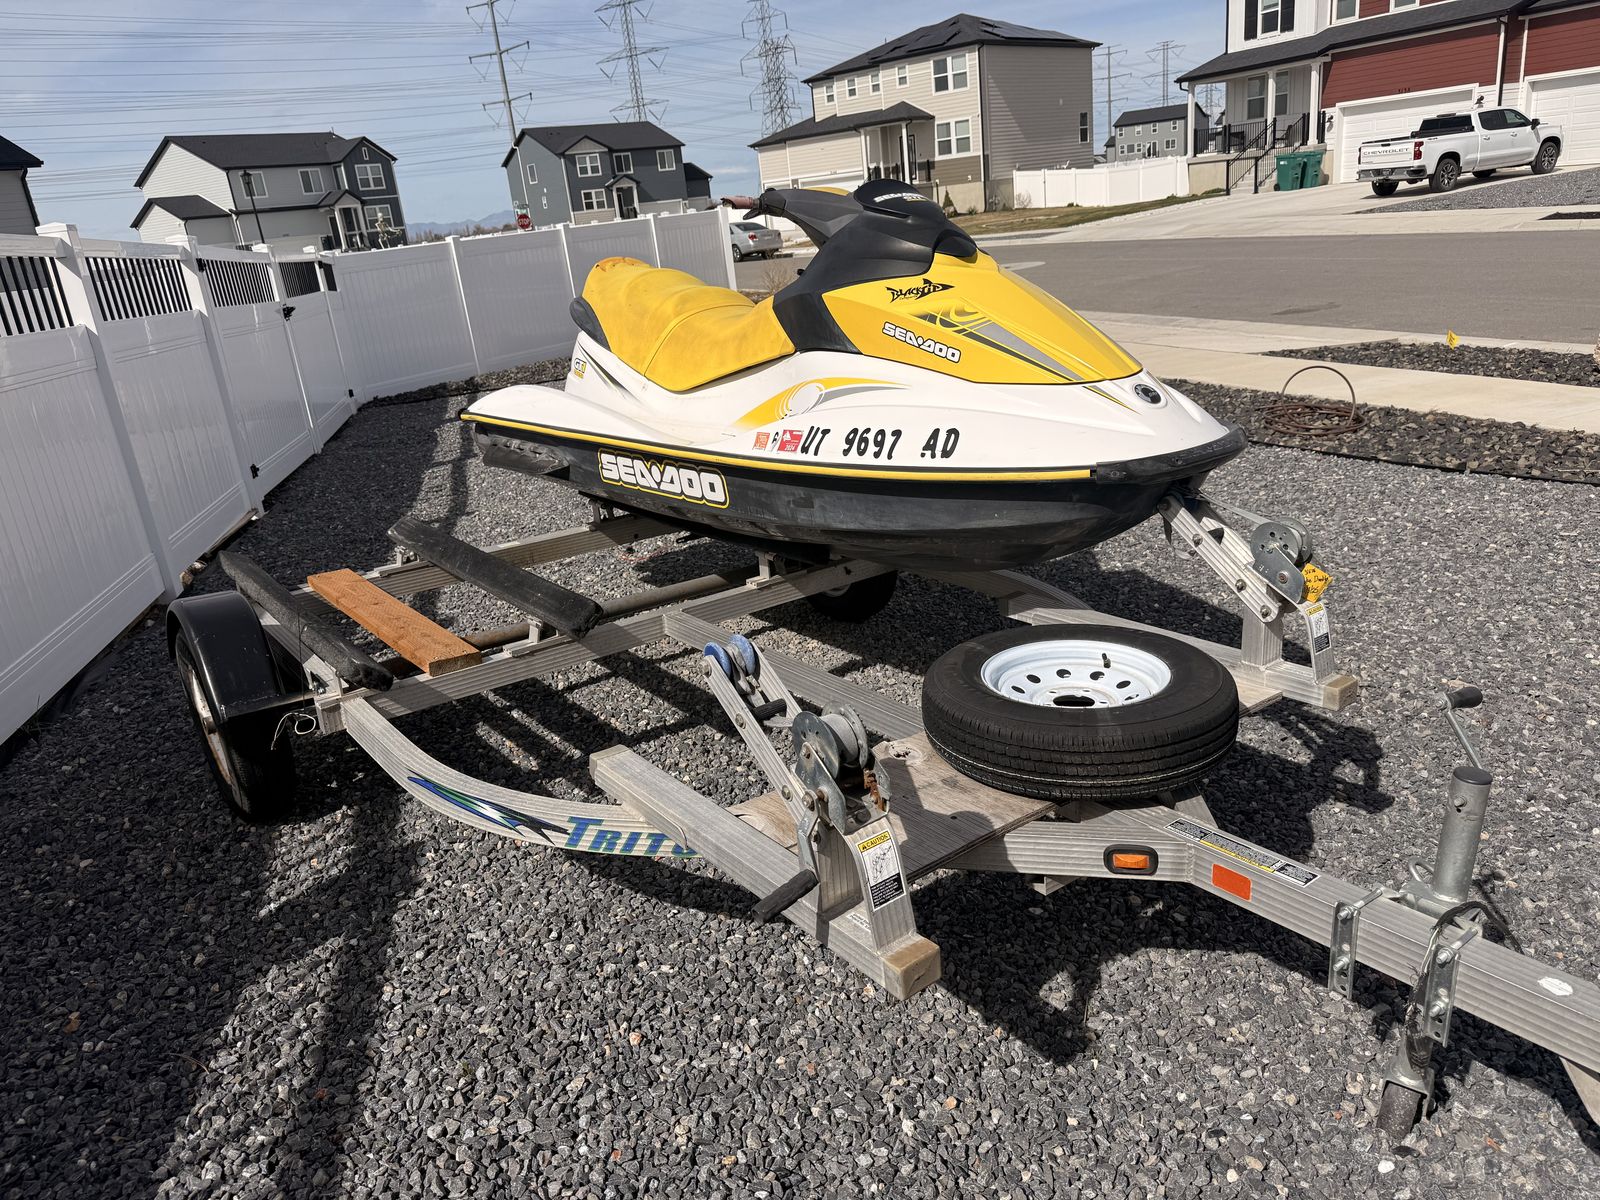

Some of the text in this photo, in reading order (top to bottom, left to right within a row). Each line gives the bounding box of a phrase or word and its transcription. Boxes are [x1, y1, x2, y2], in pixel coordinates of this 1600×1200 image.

[1363, 147, 1410, 156] CHEVROLET
[518, 217, 531, 226] STOP
[801, 426, 831, 456] UT
[842, 428, 902, 460] 9697
[920, 428, 960, 459] AD
[866, 834, 889, 848] CAUTION
